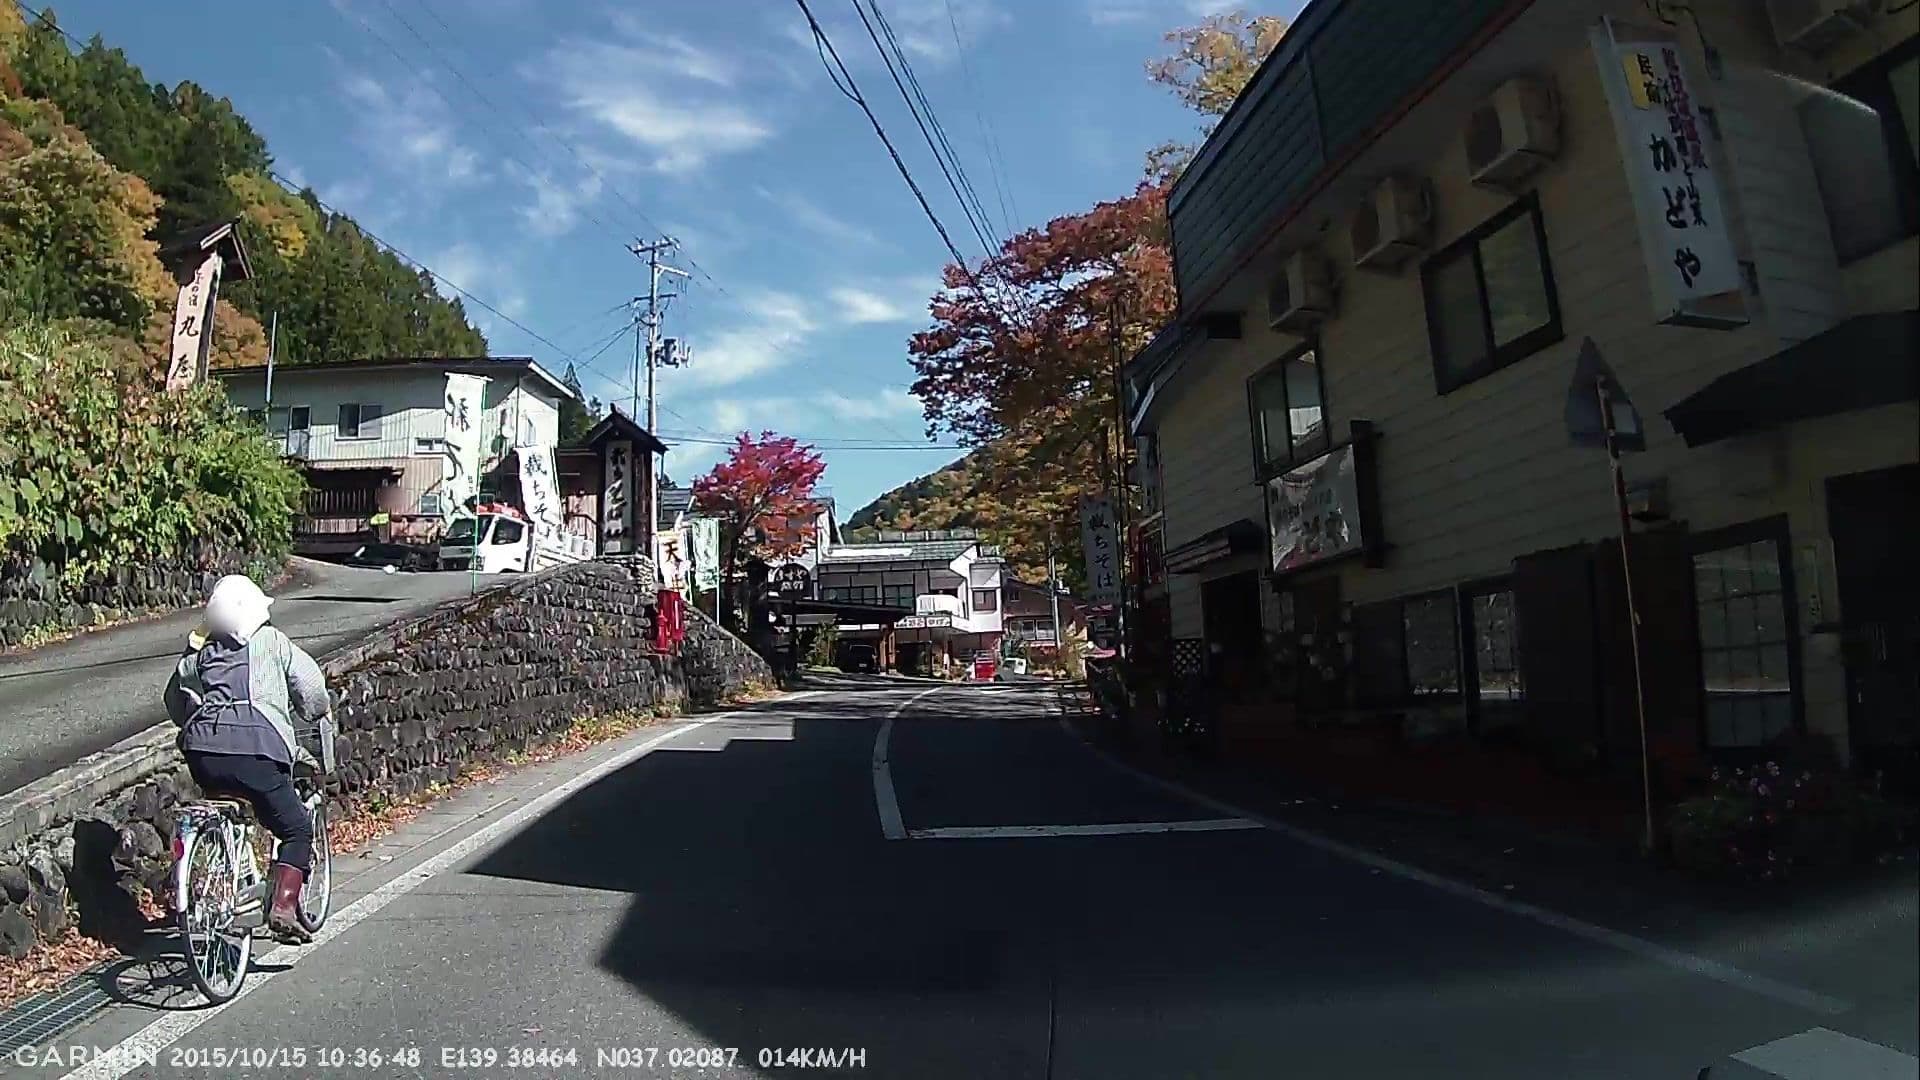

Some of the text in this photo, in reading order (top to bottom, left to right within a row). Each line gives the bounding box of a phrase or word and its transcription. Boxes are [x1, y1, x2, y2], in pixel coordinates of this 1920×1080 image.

[1637, 53, 1661, 104] 民宿
[1648, 133, 1701, 288] かどや
